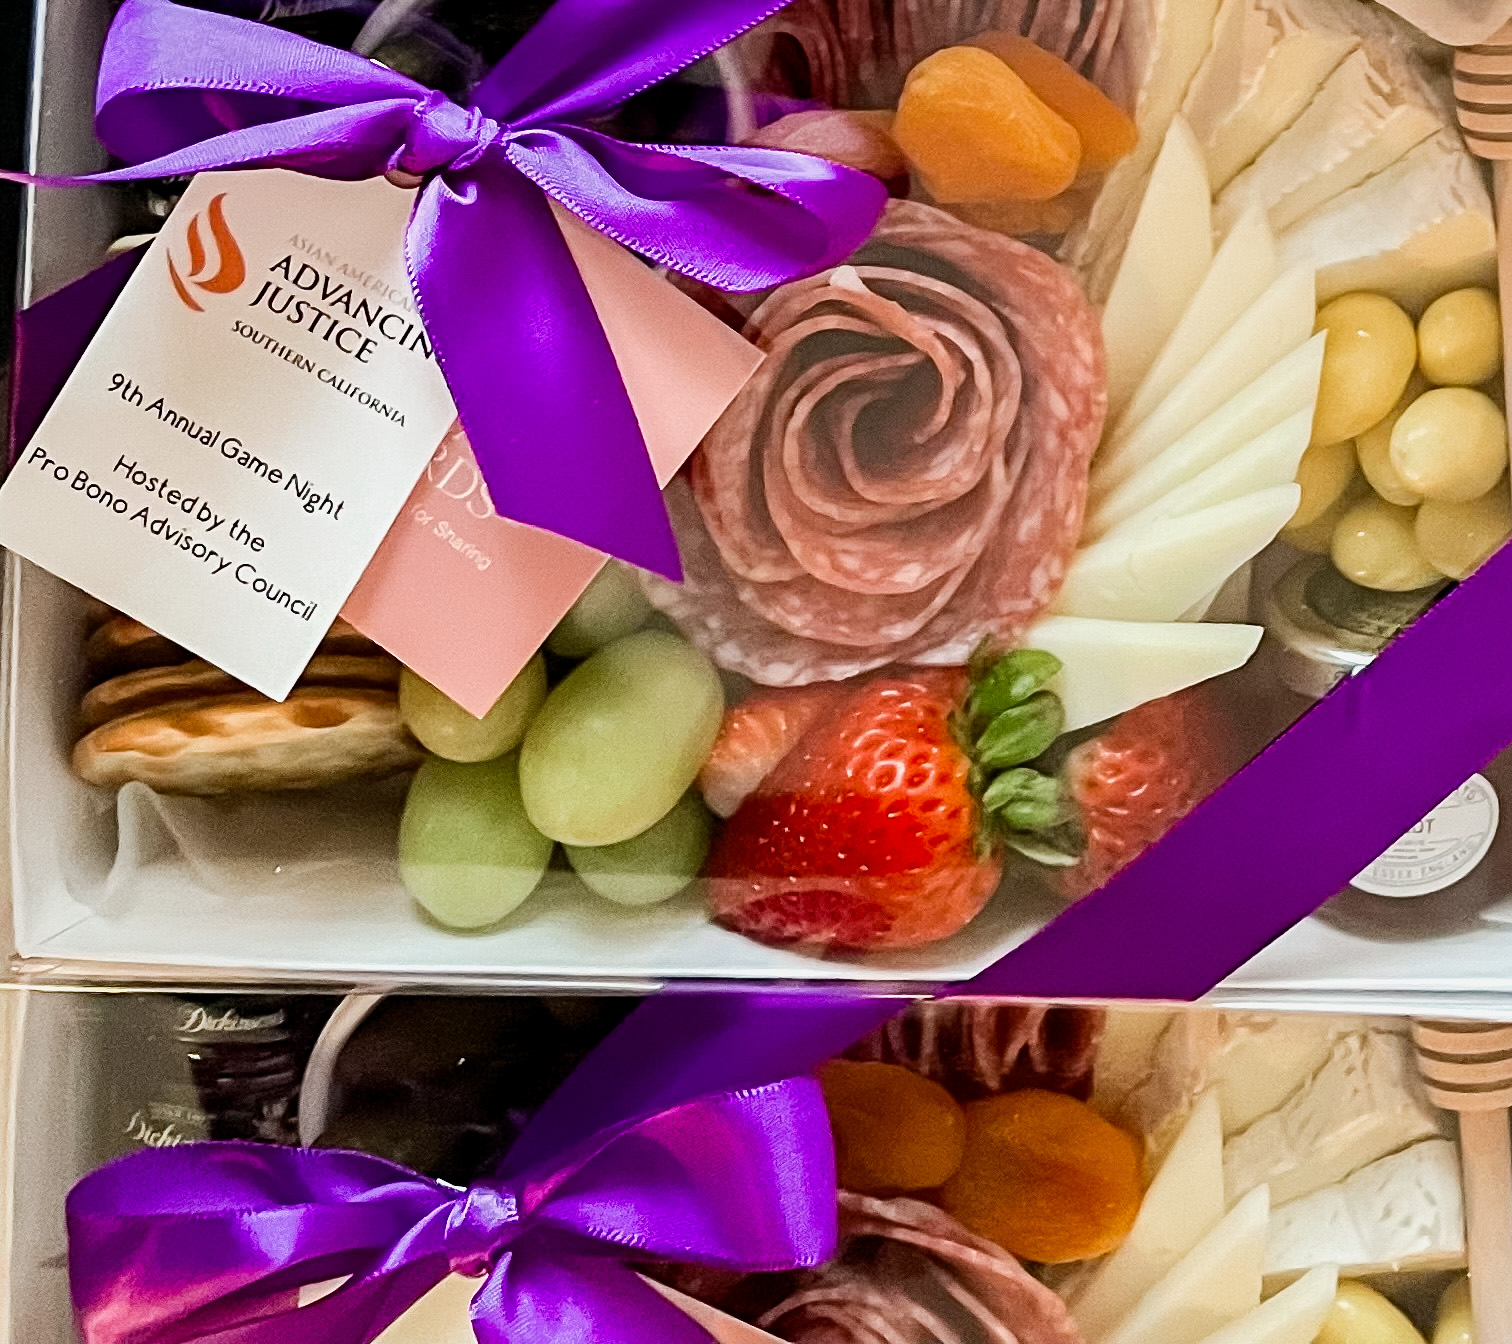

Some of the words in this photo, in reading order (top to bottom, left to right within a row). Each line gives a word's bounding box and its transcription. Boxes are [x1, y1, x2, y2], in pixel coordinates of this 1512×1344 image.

[249, 282, 378, 363] JUSTICE
[270, 254, 434, 359] ADVANCIN
[289, 234, 333, 266] ASIAN
[338, 264, 417, 312] AMERICA
[232, 320, 316, 373] SOUTHERN
[317, 369, 406, 427] CALIFORNIA
[108, 373, 143, 406] 9th
[145, 397, 220, 447] Annual
[220, 438, 283, 483] Game
[284, 474, 345, 520] Night
[28, 447, 69, 481] Pro
[71, 470, 128, 514] Bono
[130, 507, 232, 574] Advisory
[235, 564, 317, 621] Council
[113, 454, 198, 512] Hosted
[196, 501, 225, 531] by
[230, 519, 265, 552] the
